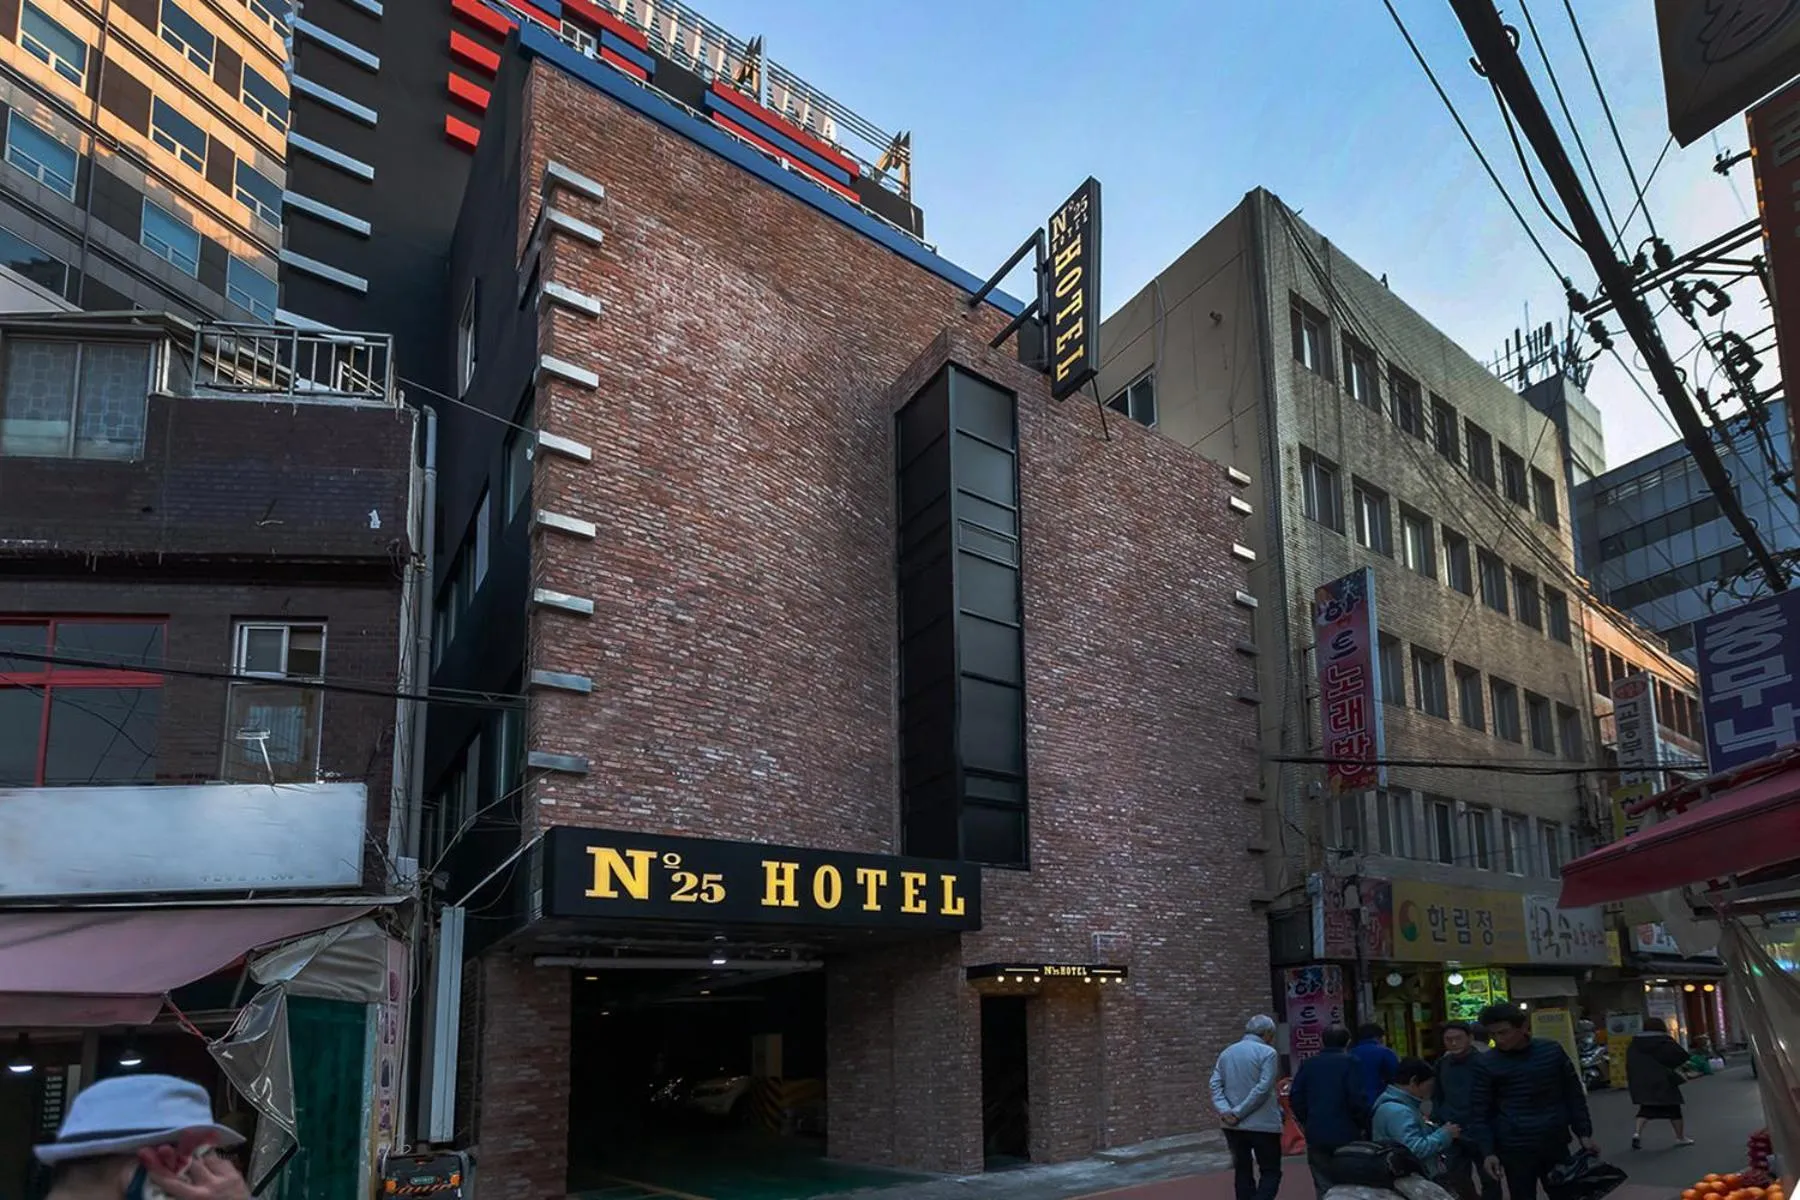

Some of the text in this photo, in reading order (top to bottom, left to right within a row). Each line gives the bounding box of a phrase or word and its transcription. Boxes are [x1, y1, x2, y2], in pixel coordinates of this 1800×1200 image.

[1054, 232, 1085, 382] HOTEL
[760, 859, 966, 917] HOTEL
[1426, 903, 1494, 946] 한림정
